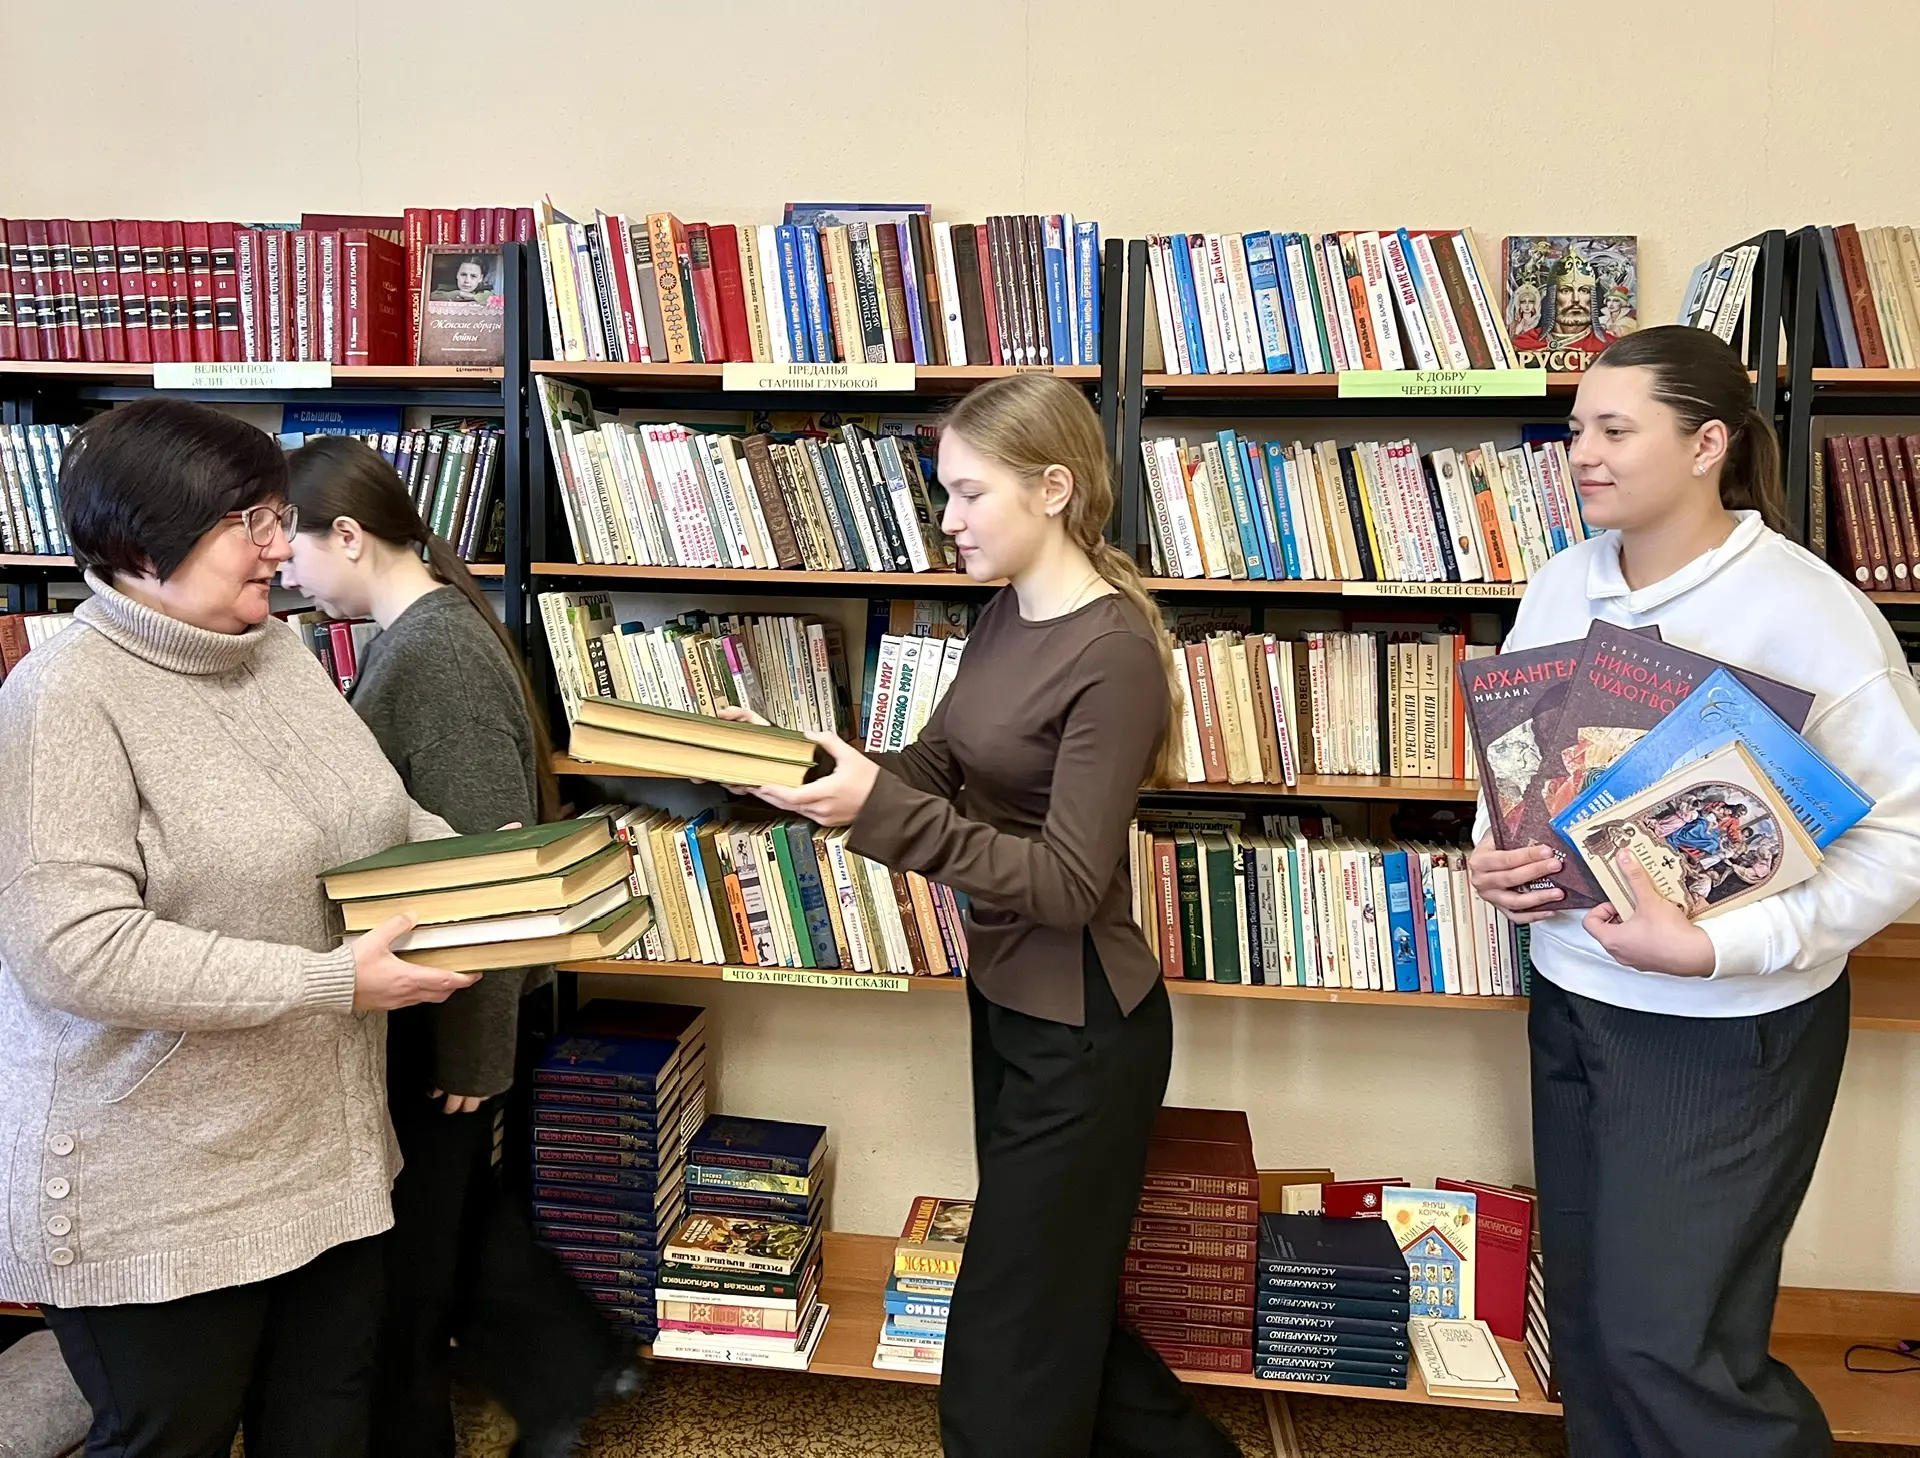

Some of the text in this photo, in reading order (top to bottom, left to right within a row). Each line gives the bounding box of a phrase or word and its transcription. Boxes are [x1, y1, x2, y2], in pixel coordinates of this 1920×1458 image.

[784, 242, 793, 267] ГРЕЦИИ
[1210, 238, 1226, 284] Дон Кихот
[1388, 240, 1405, 272] СНИЛОСЬ
[1398, 272, 1408, 281] НЕ
[1403, 288, 1416, 306] ВАМ
[1377, 294, 1390, 340] ПАВЕЛ БАЖОВ
[759, 378, 878, 389] СТАРИНЫ ГЛУБОКОЙ
[788, 366, 849, 376] ПРЕДАНЬЯ
[1401, 385, 1482, 395] ЧЕРЕЗ КНИГУ
[1416, 372, 1468, 382] К ДОБРУ
[592, 460, 607, 494] ПРИРОДЕ
[718, 470, 735, 511] БАГРИЦКИЙ
[1224, 440, 1250, 524] КАПИТАН ВРУНГЕЛЬ
[1273, 465, 1290, 536] МЭРИ ПОППИНС
[604, 504, 618, 542] РАССКАЗЫ
[1177, 514, 1193, 556] МАРК ТВЕН
[1376, 584, 1516, 596] ЧИТАЕМ ВСЕЙ СЕМЬЕЙ
[688, 647, 706, 706] СТАРЫЙ ДОМ
[1594, 652, 1692, 698] НИКОЛАЙ
[1601, 641, 1694, 680] СВЯТИТЕЛЬ
[870, 661, 893, 748] ПОЗНАЮ МИР
[889, 664, 914, 748] ПОЗНАЮ МИР
[1298, 664, 1308, 714] ПОВЕСТИ
[1474, 688, 1530, 703] МИХАИЛ
[1589, 670, 1676, 715] ЧУДОТВО
[1273, 686, 1292, 782] ПРИКЛЮЧЕНИЯ БУРАТИНО
[1404, 694, 1416, 758] ХРЕСТОМАТИЯ
[1424, 695, 1436, 760] ХРЕСТОМАТИЯ
[1300, 846, 1310, 915] ОСТРОВ СОКРОВИЩ
[1343, 868, 1352, 900] МИЛЛИОН
[1350, 861, 1360, 906] ПРИКЛЮЧЕНИЙ
[1530, 882, 1556, 890] ИКОНА
[1633, 842, 1675, 898] БИБЛИЯ
[732, 970, 899, 989] ЧТО ЗА ПРЕЛЕСТЬ ЭТИ СКАЗКИ
[1418, 1208, 1450, 1218] КОРЧАК
[1422, 1201, 1446, 1209] ЯНУШ
[662, 1276, 766, 1292] детская библиотека
